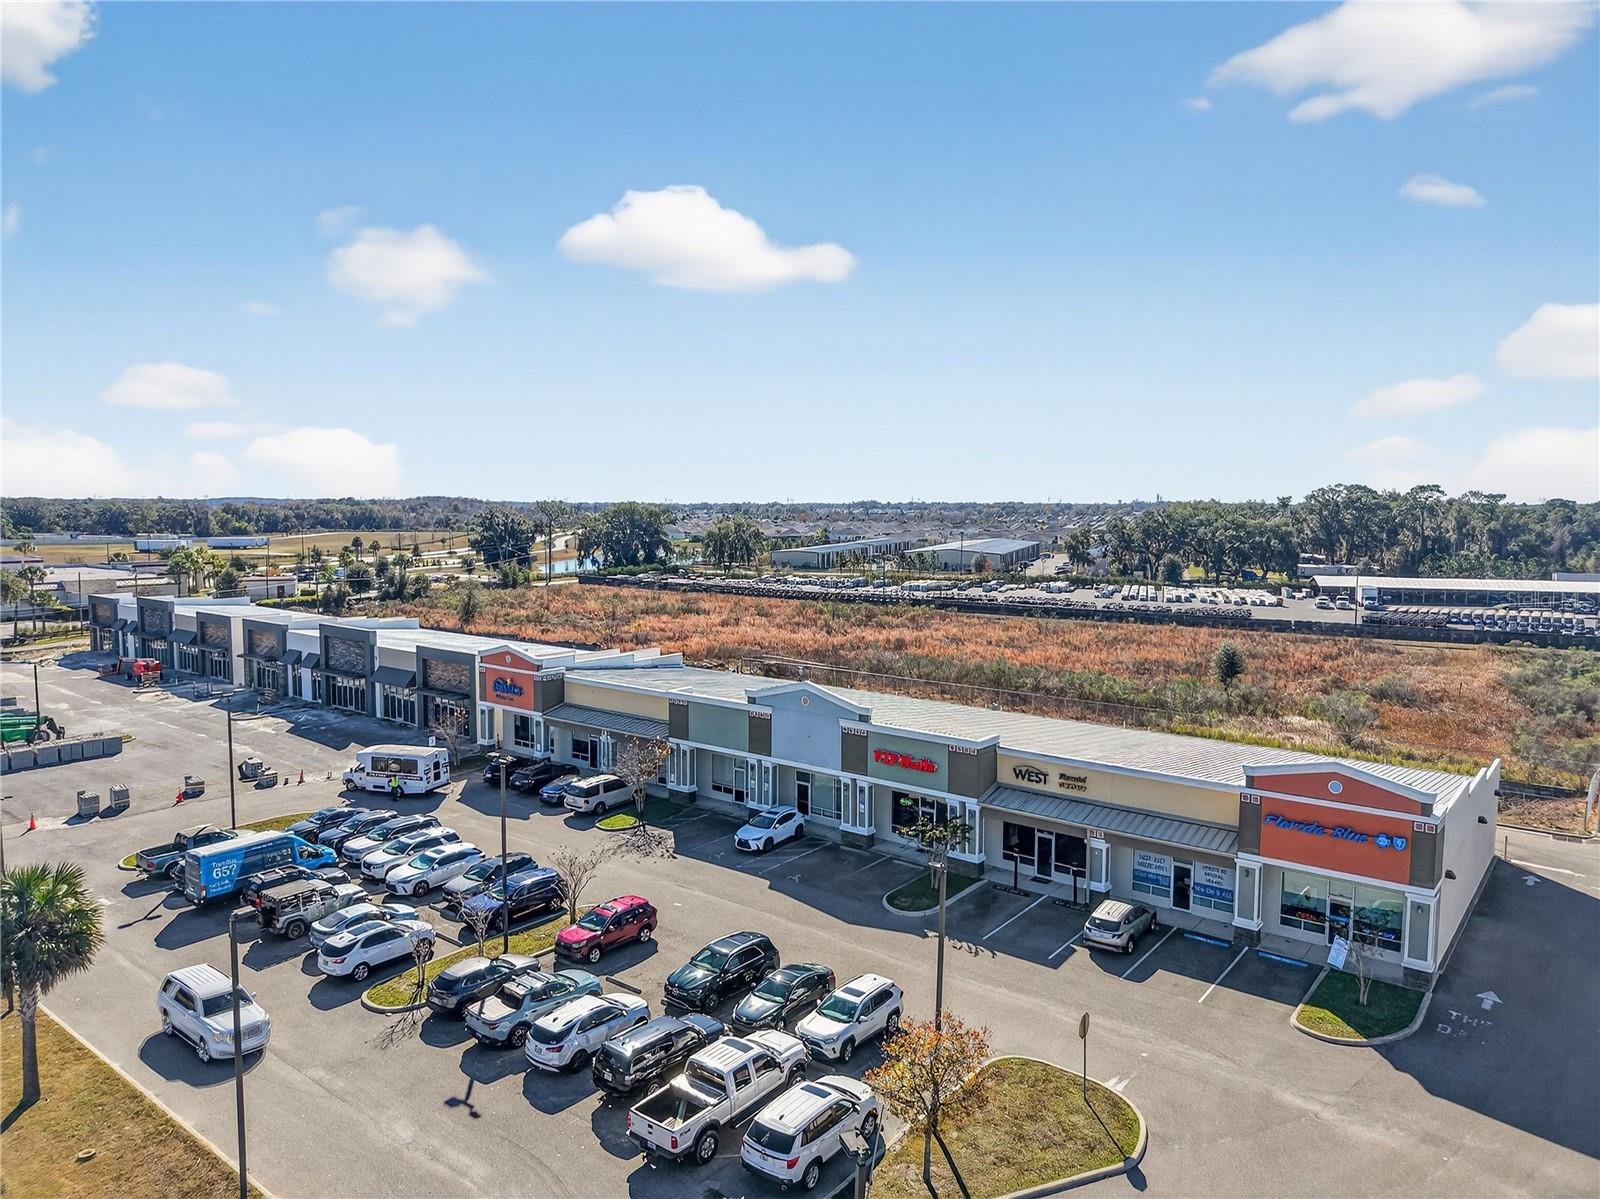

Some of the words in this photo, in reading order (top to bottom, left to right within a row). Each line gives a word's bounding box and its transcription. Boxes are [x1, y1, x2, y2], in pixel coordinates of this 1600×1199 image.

[1013, 767, 1049, 785] WEST
[1263, 813, 1327, 836] Florida
[1330, 825, 1369, 844] Blue
